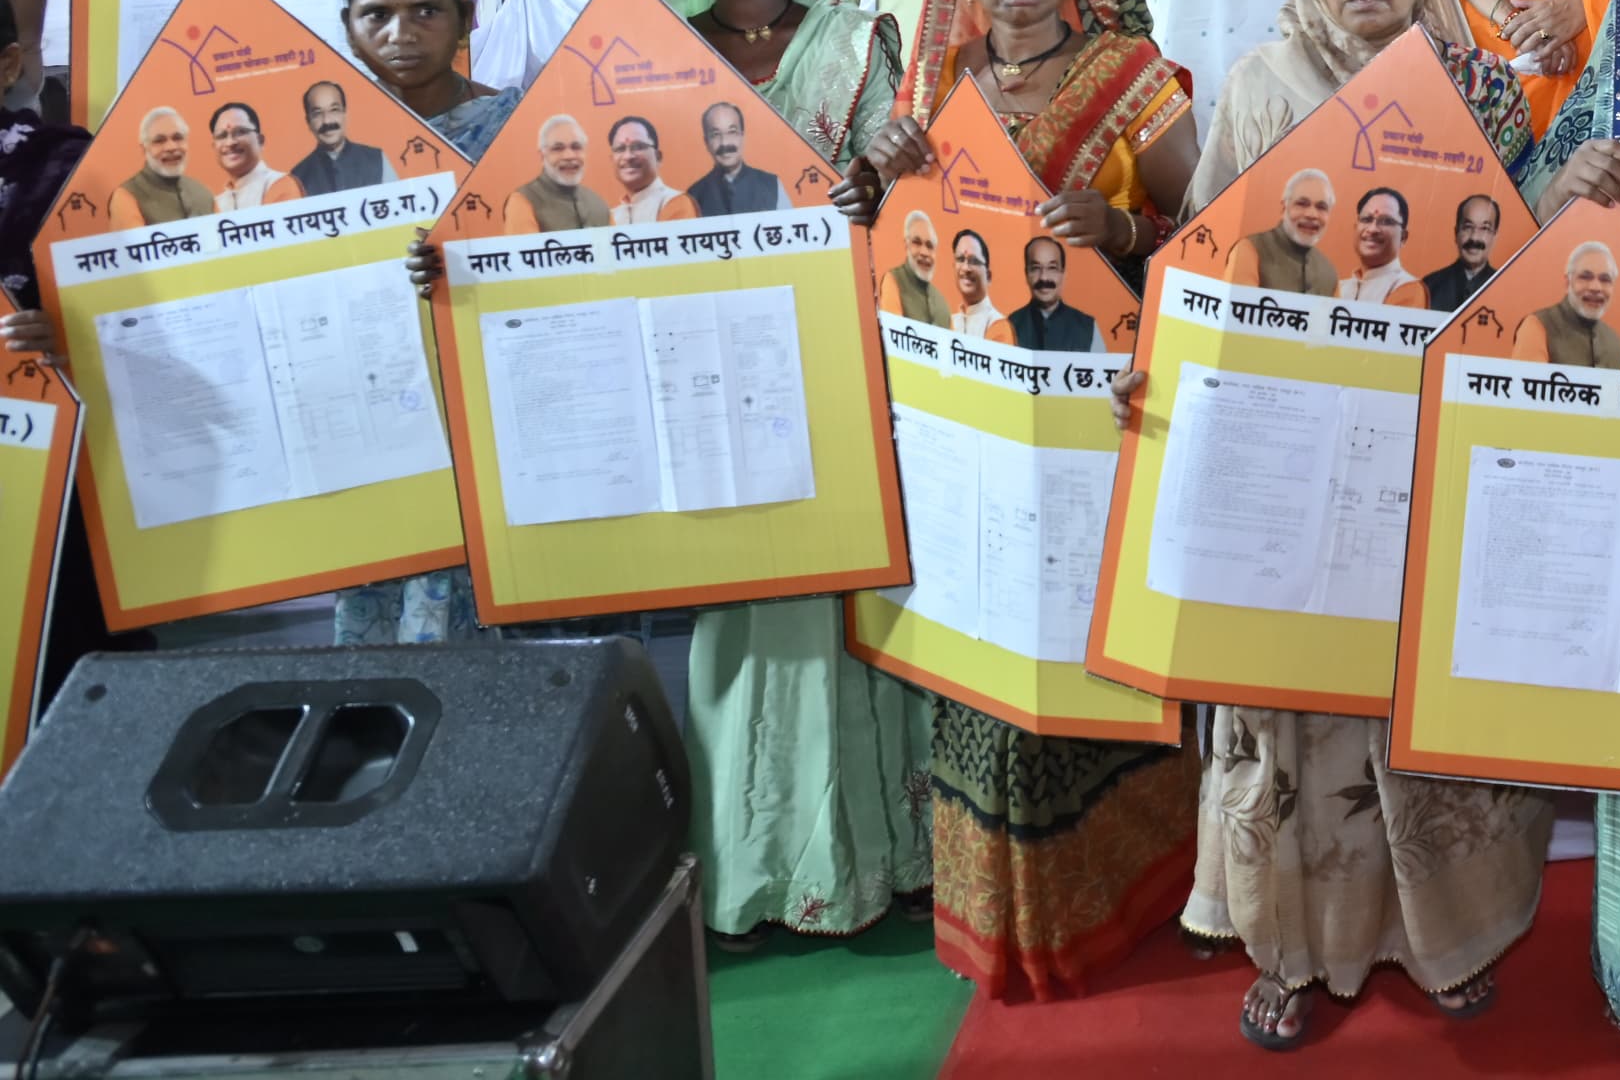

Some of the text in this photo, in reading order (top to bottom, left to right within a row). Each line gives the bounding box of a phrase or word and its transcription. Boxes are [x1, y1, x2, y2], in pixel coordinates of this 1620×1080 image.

[1466, 155, 1484, 174] 2.0
[75, 188, 438, 272] नगर पालिक निगम रायपुर (छ.ग.)
[468, 218, 831, 273] नगर पालिक निगम रायपुर (छ.ग.)
[1184, 289, 1221, 319] नगर
[1231, 296, 1309, 332] पालिक
[1330, 306, 1390, 342] निगम
[890, 326, 937, 358] पालिक
[951, 339, 991, 372] निगम
[999, 359, 1050, 396] रायपुर
[1467, 373, 1512, 398] नगर
[1522, 372, 1601, 405] पालिक
